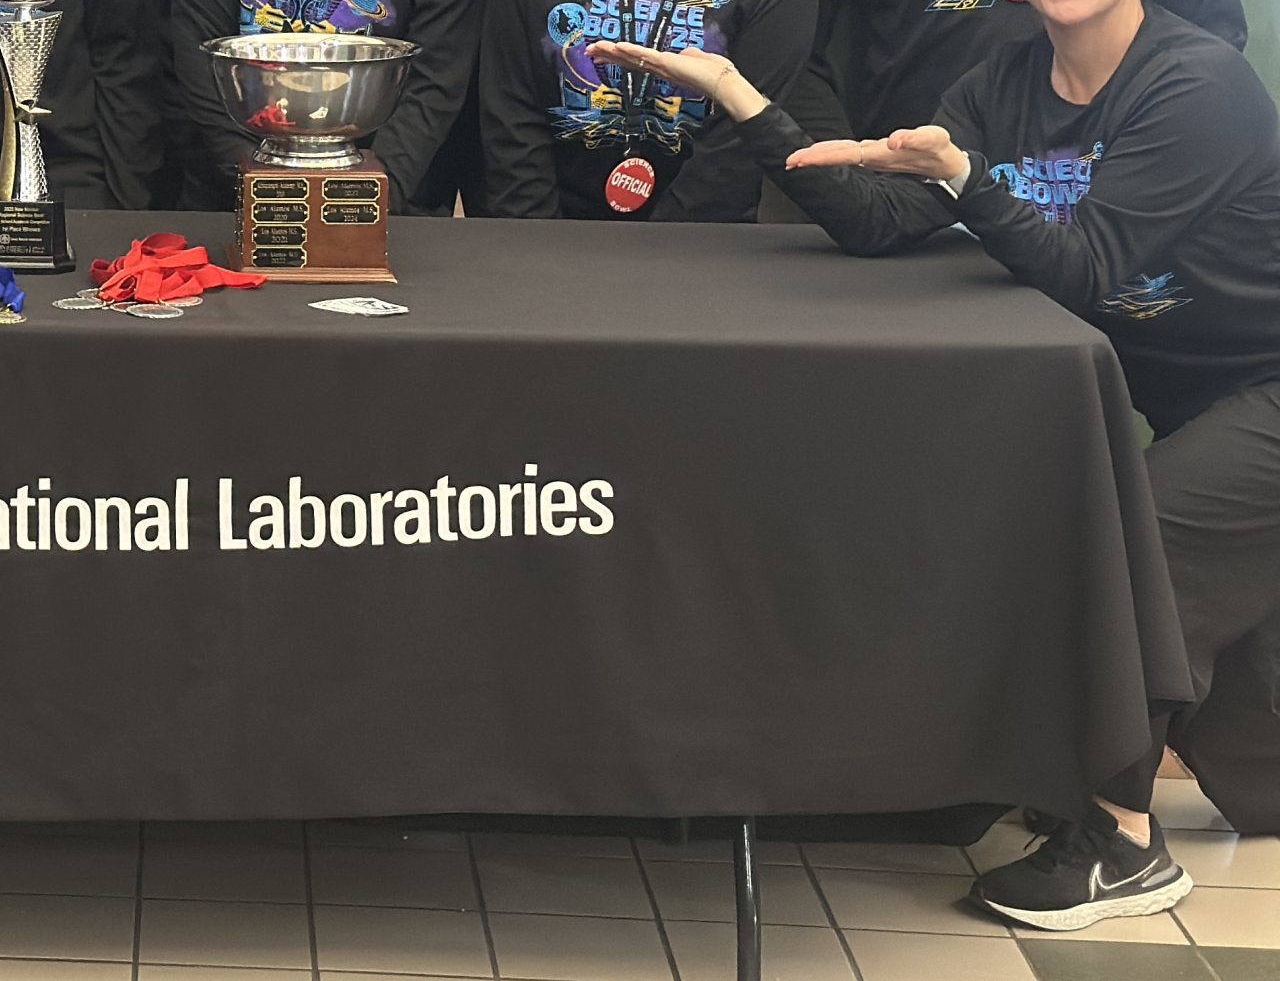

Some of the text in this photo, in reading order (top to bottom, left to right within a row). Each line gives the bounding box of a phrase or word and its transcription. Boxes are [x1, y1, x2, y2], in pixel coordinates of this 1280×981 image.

[623, 159, 655, 179] SCIENCE
[611, 171, 652, 198] OFFICIAL
[609, 200, 633, 213] BOWL
[218, 464, 614, 550] Laboratories
